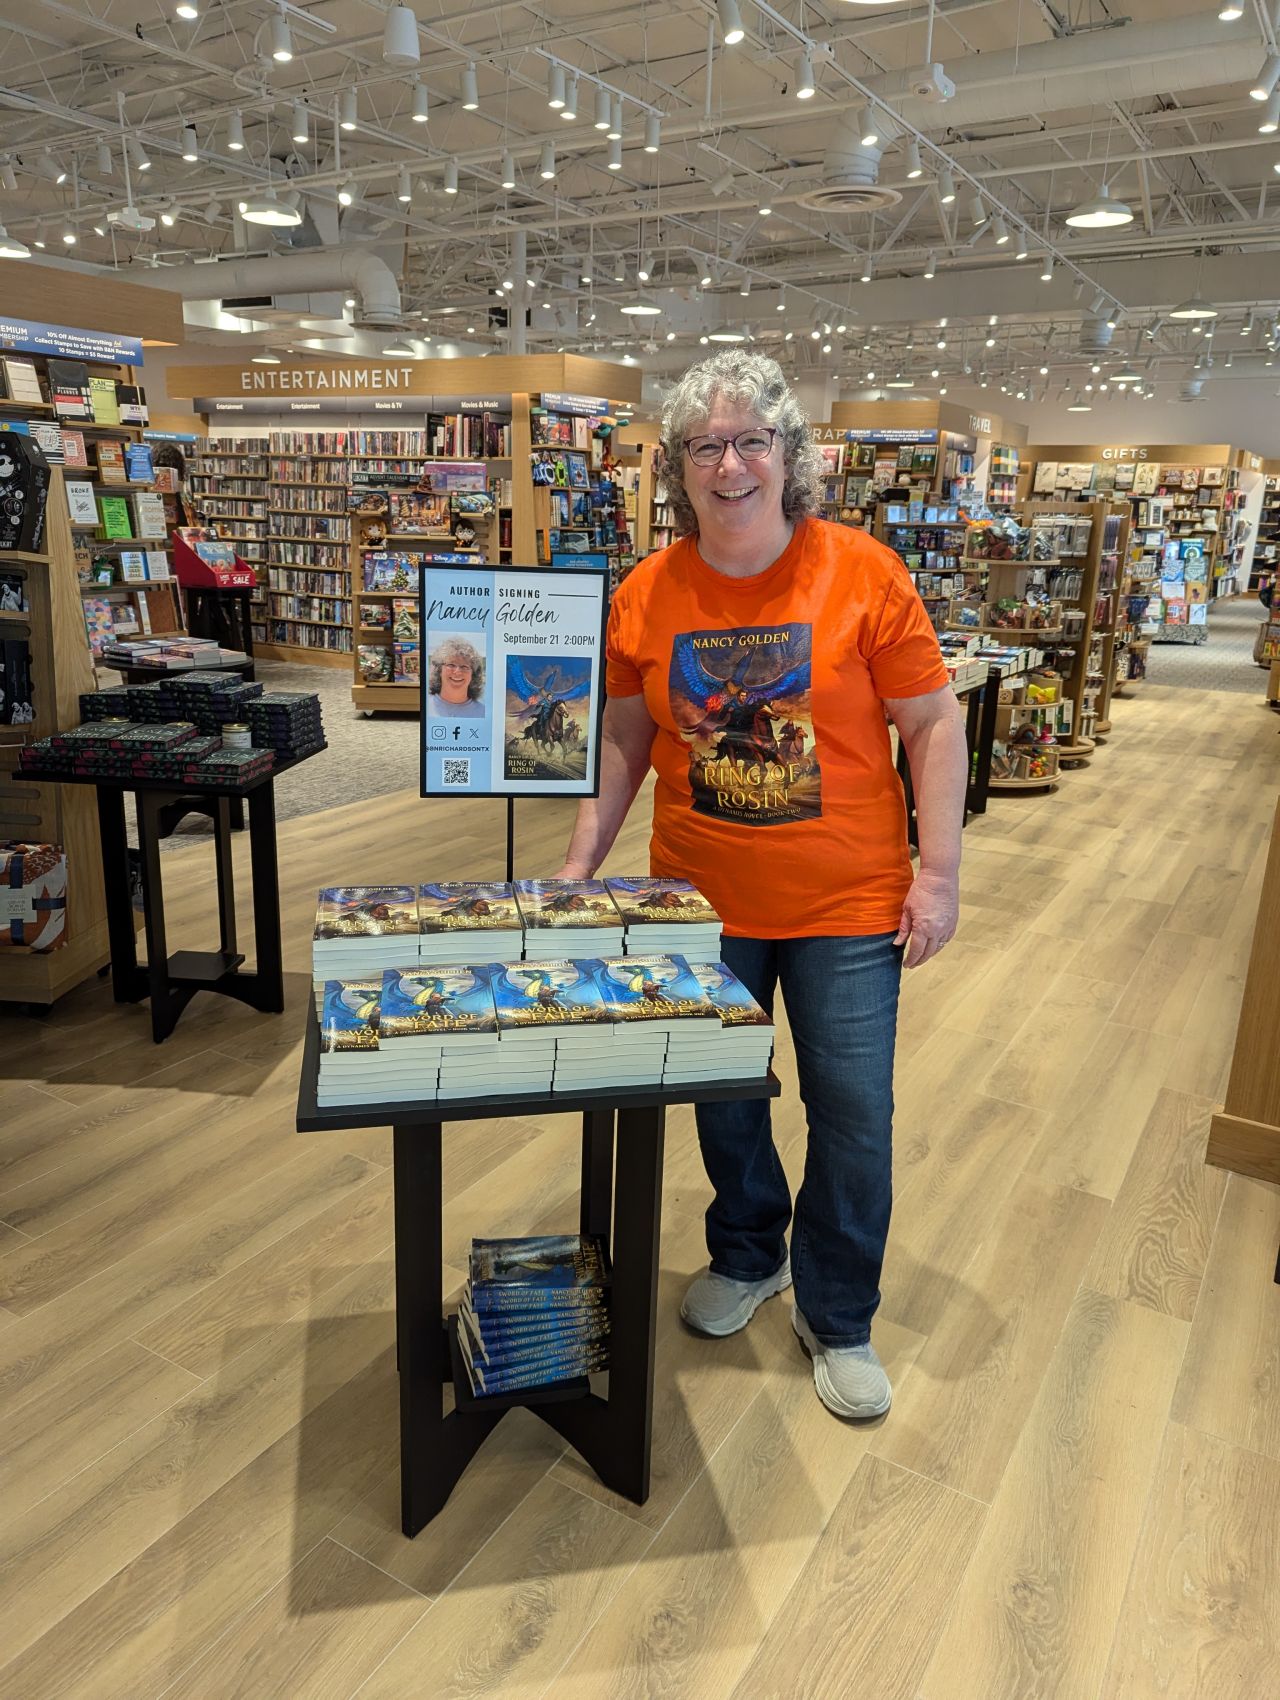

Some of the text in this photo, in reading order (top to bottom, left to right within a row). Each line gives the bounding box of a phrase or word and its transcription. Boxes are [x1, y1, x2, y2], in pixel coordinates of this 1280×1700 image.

[0, 325, 28, 335] EMIUM
[35, 337, 53, 345] Collect
[54, 340, 72, 348] Stamps
[86, 337, 112, 346] Everything
[241, 368, 413, 390] ENTERTAINMENT
[968, 414, 992, 433] TRAVEL
[812, 428, 846, 440] RAP
[1102, 448, 1148, 459] GIFTS
[233, 576, 250, 584] SALE
[450, 586, 540, 598] AUTHOR SIGNING
[427, 600, 560, 628] Nancy Golden
[504, 633, 595, 646] September 21 2:00PM
[692, 631, 790, 650] NANCY GOLDEN
[704, 763, 800, 786] RING OF
[716, 788, 789, 810] ROSIN
[641, 1005, 690, 1014] FATE
[531, 1011, 582, 1020] FATE
[718, 1012, 742, 1020] TE
[414, 1020, 467, 1029] FATE
